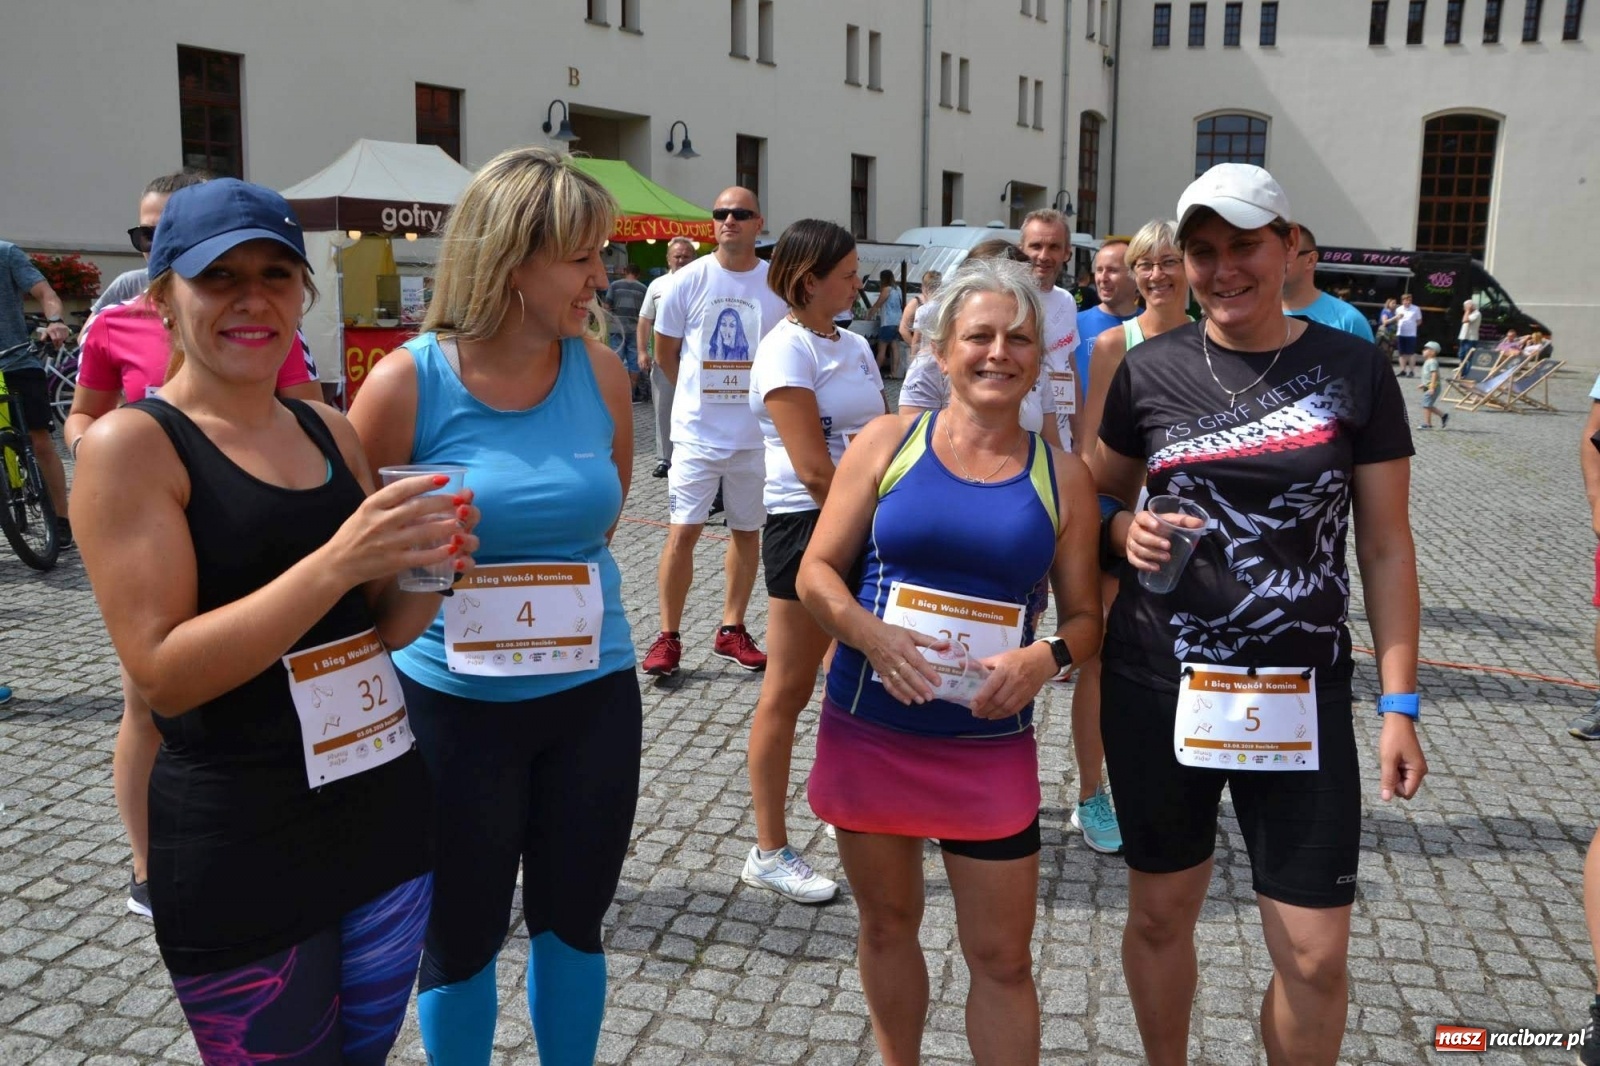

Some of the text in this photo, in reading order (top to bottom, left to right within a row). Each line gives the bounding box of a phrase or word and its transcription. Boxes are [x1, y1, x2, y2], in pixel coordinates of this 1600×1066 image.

[568, 66, 580, 87] B
[381, 203, 442, 232] gofry
[1322, 250, 1411, 265] BBQ TRUCK
[722, 375, 738, 386] 44
[1053, 386, 1065, 397] 34
[1164, 364, 1332, 442] KS GRYF KIETRZ
[476, 576, 499, 585] Bieg
[502, 572, 534, 582] Wokół
[537, 573, 574, 581] Komina
[516, 601, 536, 628] 4
[917, 599, 938, 612] Bieg
[940, 603, 969, 615] Wokół
[970, 609, 1004, 621] Komina
[321, 656, 347, 669] Bieg
[357, 674, 388, 712] 32
[1211, 680, 1231, 690] Bieg
[1233, 681, 1263, 690] Wokół
[1265, 682, 1297, 690] Komina
[1244, 707, 1261, 732] 5
